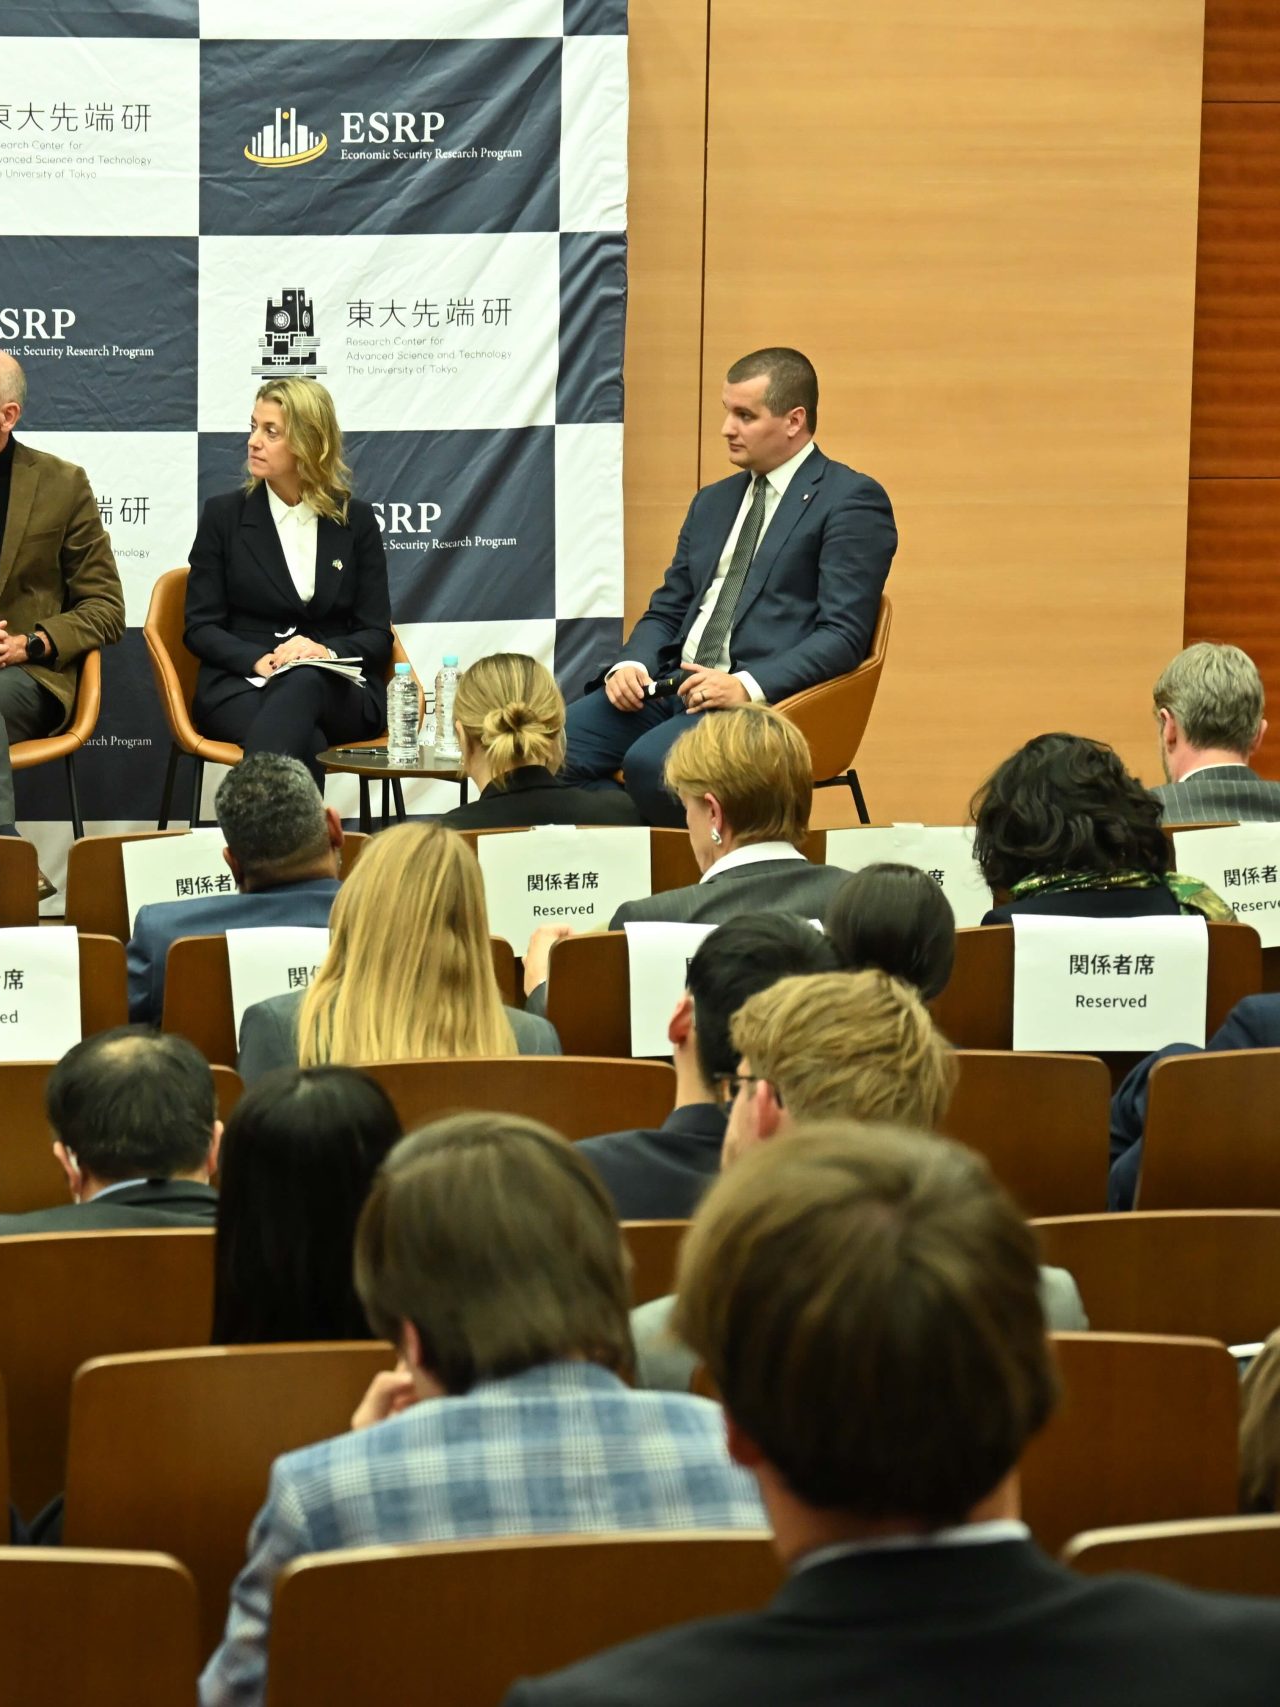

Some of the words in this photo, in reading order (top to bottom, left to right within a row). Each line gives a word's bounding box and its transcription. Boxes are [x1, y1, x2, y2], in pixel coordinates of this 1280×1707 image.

[341, 112, 444, 143] ESRP
[32, 140, 64, 150] Center
[70, 141, 82, 150] for
[36, 155, 73, 164] Science
[76, 156, 94, 164] and
[98, 155, 151, 167] Technology
[341, 149, 391, 160] Economic
[393, 149, 432, 161] Security
[435, 148, 478, 159] Research
[480, 148, 522, 161] Program
[6, 169, 52, 179] University
[55, 169, 64, 178] of
[69, 169, 96, 180] Tokyo
[347, 297, 512, 328] 東大先端研
[346, 337, 390, 346] Research
[394, 336, 427, 346] Center
[431, 336, 444, 345] for
[23, 345, 63, 359] Security
[66, 345, 109, 356] Research
[112, 345, 154, 359] Program
[347, 352, 394, 360] Advanced
[398, 351, 434, 360] Science
[437, 351, 455, 359] and
[459, 350, 511, 360] Technology
[347, 366, 364, 374] The
[368, 366, 413, 376] University
[416, 365, 426, 373] of
[429, 364, 457, 374] Tokyo
[371, 502, 442, 534] SRP
[390, 539, 429, 552] Security
[432, 536, 472, 549] Research
[475, 536, 516, 549] Program
[114, 548, 150, 559] hnology
[83, 735, 108, 746] arch
[111, 735, 152, 749] Program
[528, 872, 598, 892] 関係者席
[1223, 865, 1278, 888] 関係者
[176, 874, 237, 896] 関係者
[534, 903, 594, 916] Reserved
[1232, 899, 1280, 912] Reserv
[1070, 954, 1155, 975] 関係者席
[1076, 994, 1147, 1008] Reserved
